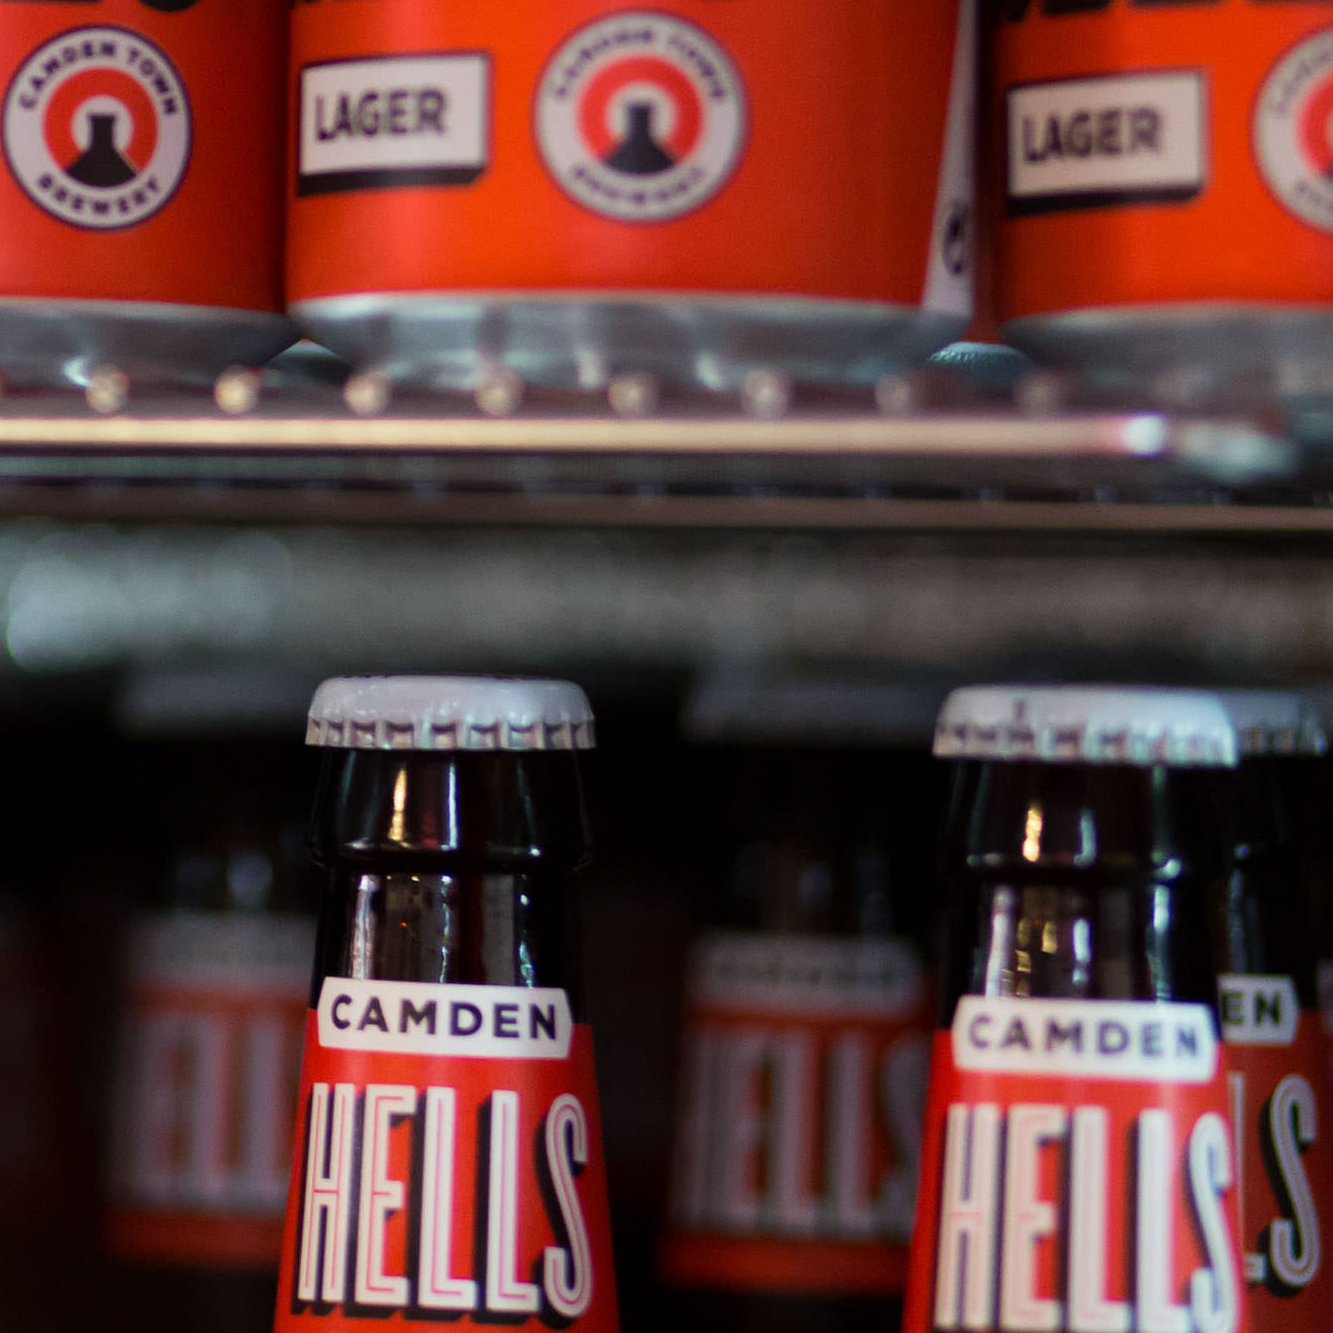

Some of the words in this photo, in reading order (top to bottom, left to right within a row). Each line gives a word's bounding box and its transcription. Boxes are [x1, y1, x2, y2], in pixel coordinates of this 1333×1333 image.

[18, 40, 117, 111] CAMDEN
[126, 49, 179, 117] TOWN
[314, 89, 448, 142] LAGER
[1020, 104, 1164, 163] LAGER
[331, 994, 558, 1041] CAMDEN
[967, 1014, 1200, 1059] CAMDEN
[1221, 992, 1282, 1026] EN
[290, 1082, 594, 1330] HELLS
[931, 1102, 1240, 1333] HELLS
